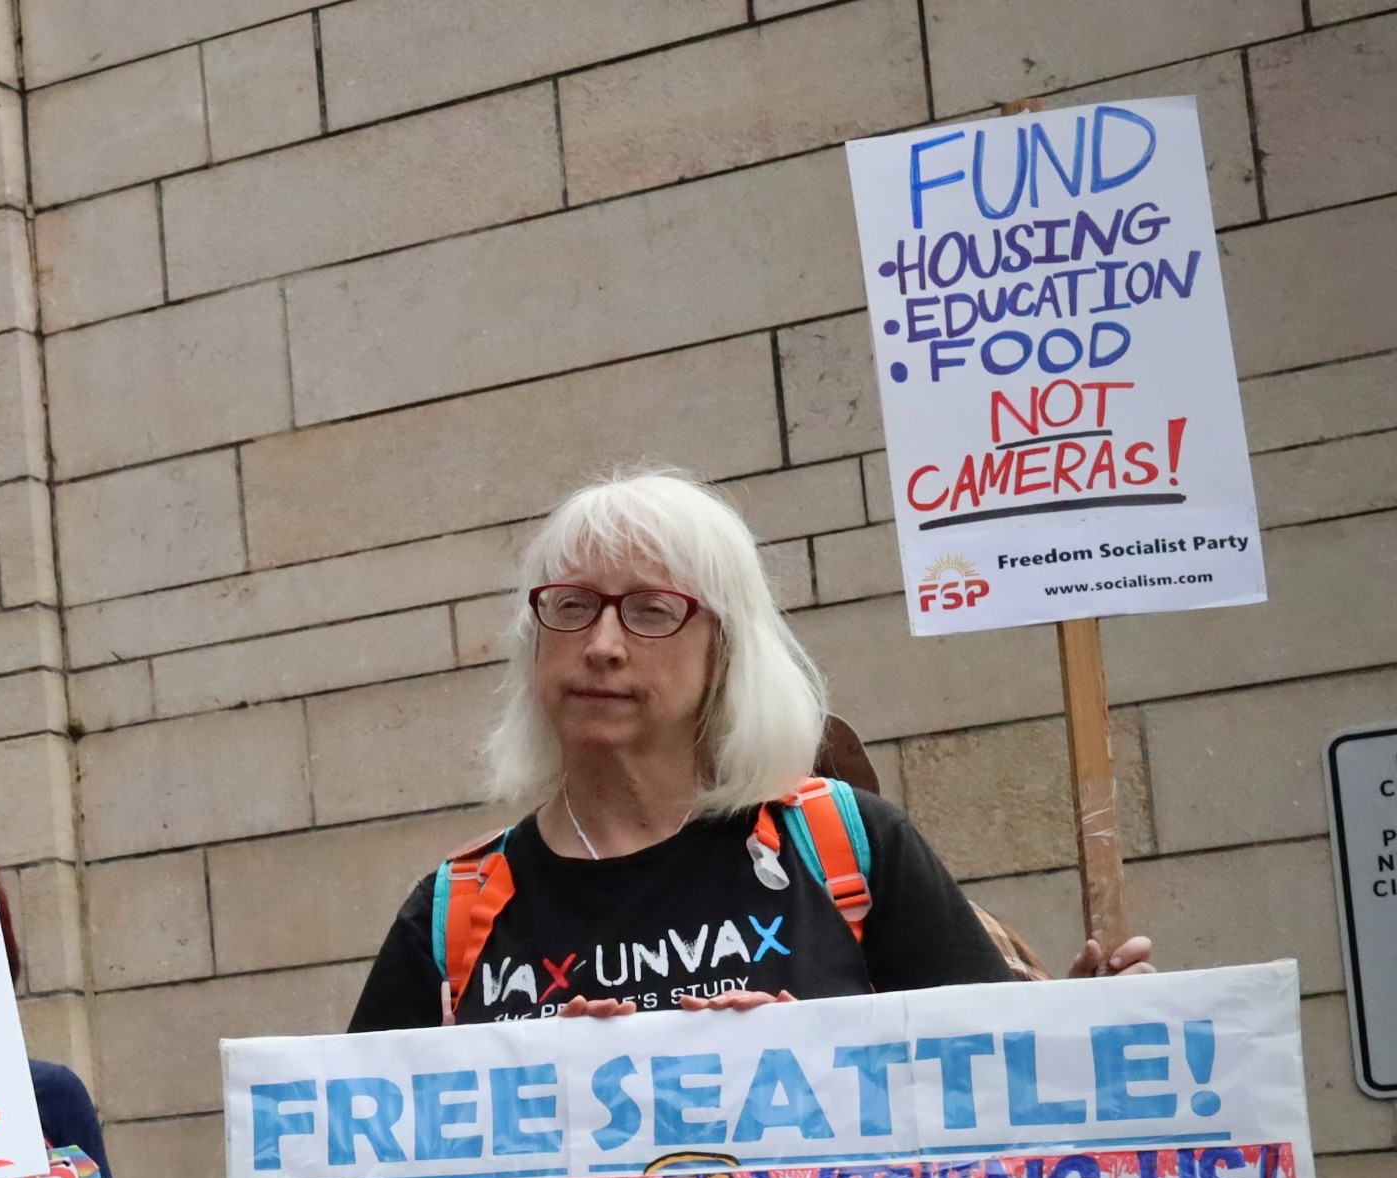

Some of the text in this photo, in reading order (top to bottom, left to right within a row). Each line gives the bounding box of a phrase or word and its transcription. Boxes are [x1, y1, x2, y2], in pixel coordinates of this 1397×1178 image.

[910, 105, 1156, 229] FUND
[897, 202, 1170, 295] HOUSING
[906, 250, 1202, 343] EDUCATION
[930, 321, 1131, 382] FOOD
[990, 378, 1135, 443] NOT
[907, 417, 1187, 512] CAMERAS!
[997, 533, 1249, 570] Freedom Socialist Party
[1044, 570, 1214, 598] www.socialism.com
[918, 578, 990, 612] FSP
[595, 915, 791, 987] UNVAX
[248, 1018, 1223, 1172] FREE SEATTLE!
